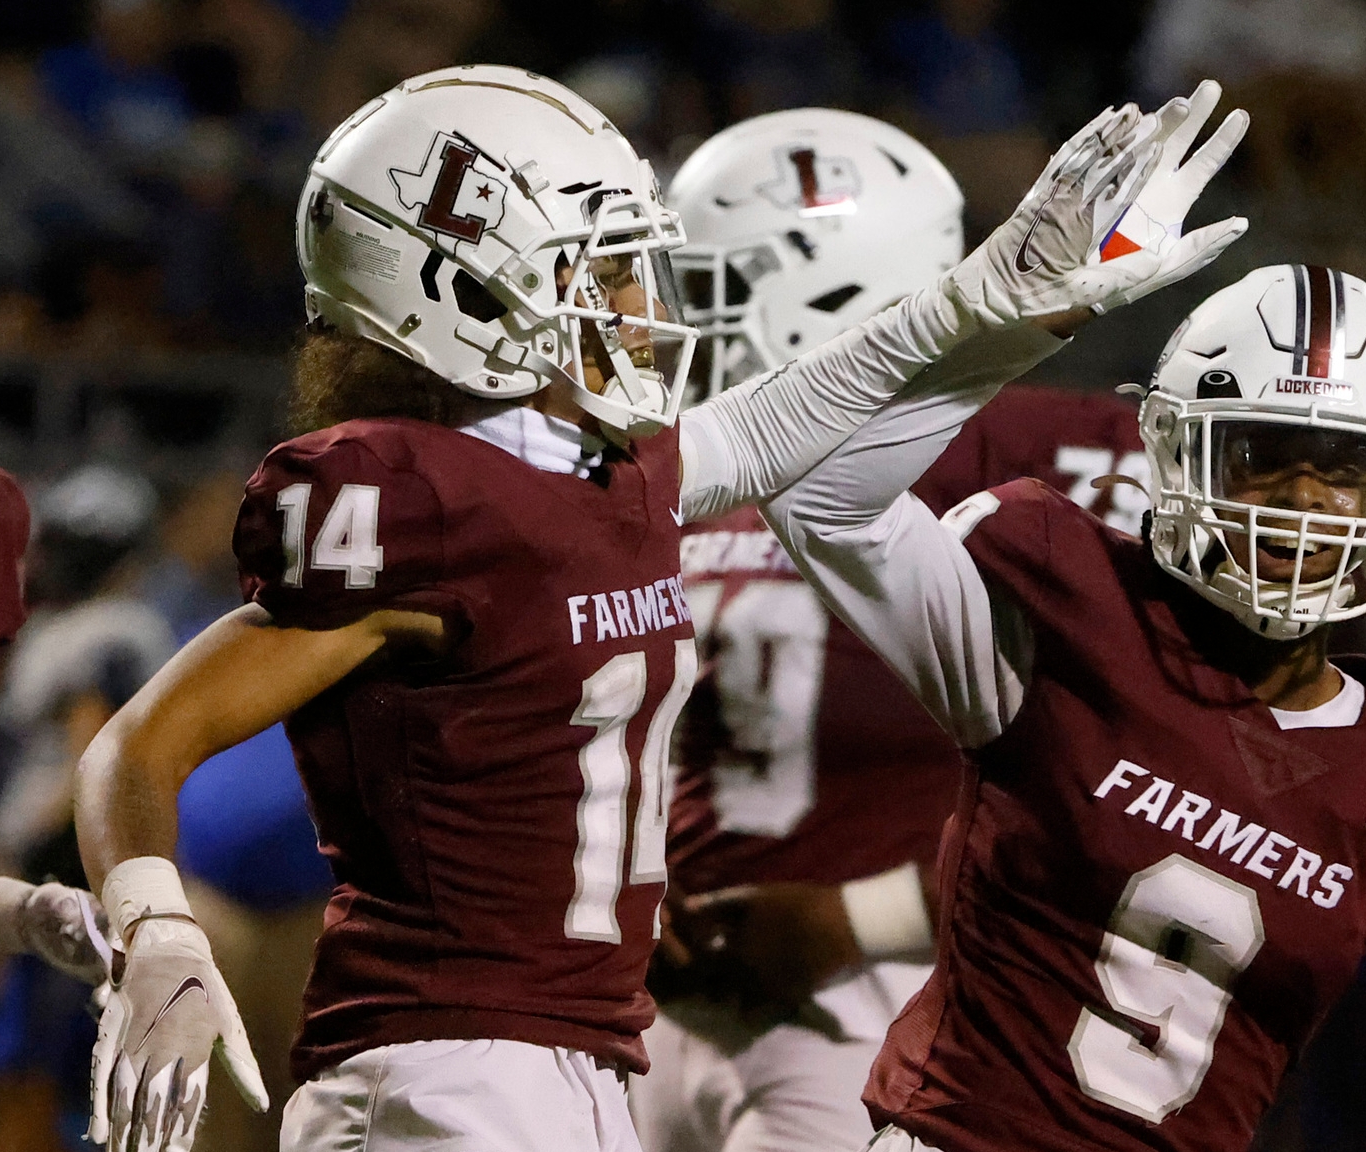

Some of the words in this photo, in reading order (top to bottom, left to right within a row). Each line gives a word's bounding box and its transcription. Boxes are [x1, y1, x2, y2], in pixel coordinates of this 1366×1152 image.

[417, 140, 487, 246] L
[1276, 378, 1332, 395] LOCKED
[276, 483, 384, 590] 14
[679, 578, 831, 840] 9
[564, 638, 701, 946] 14
[1093, 759, 1354, 909] FARMERS
[1067, 852, 1266, 1125] 9
